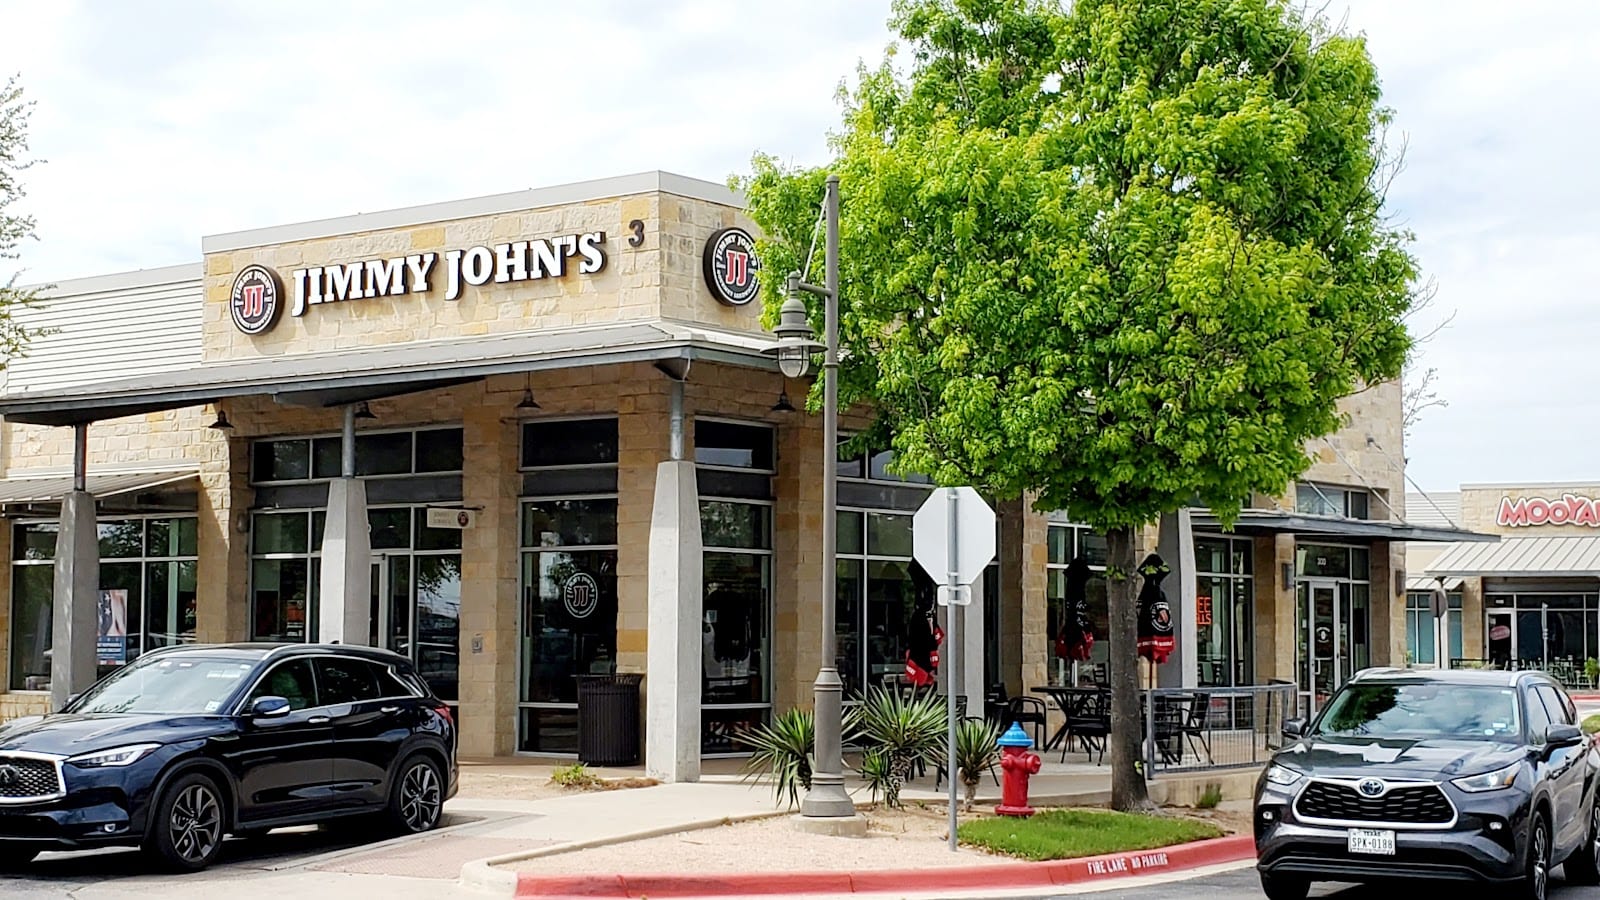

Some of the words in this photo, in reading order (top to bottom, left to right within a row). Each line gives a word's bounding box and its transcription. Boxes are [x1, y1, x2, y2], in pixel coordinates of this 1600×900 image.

[628, 219, 645, 247] 3
[291, 252, 437, 317] JIMMY
[444, 231, 607, 300] JOHN'S
[725, 249, 749, 287] JJ
[243, 284, 265, 319] JJ
[573, 585, 589, 607] JJ
[1087, 860, 1106, 875] FIRE
[1106, 857, 1128, 873] LANE
[1131, 856, 1141, 869] NO
[1141, 852, 1169, 868] PARKING
